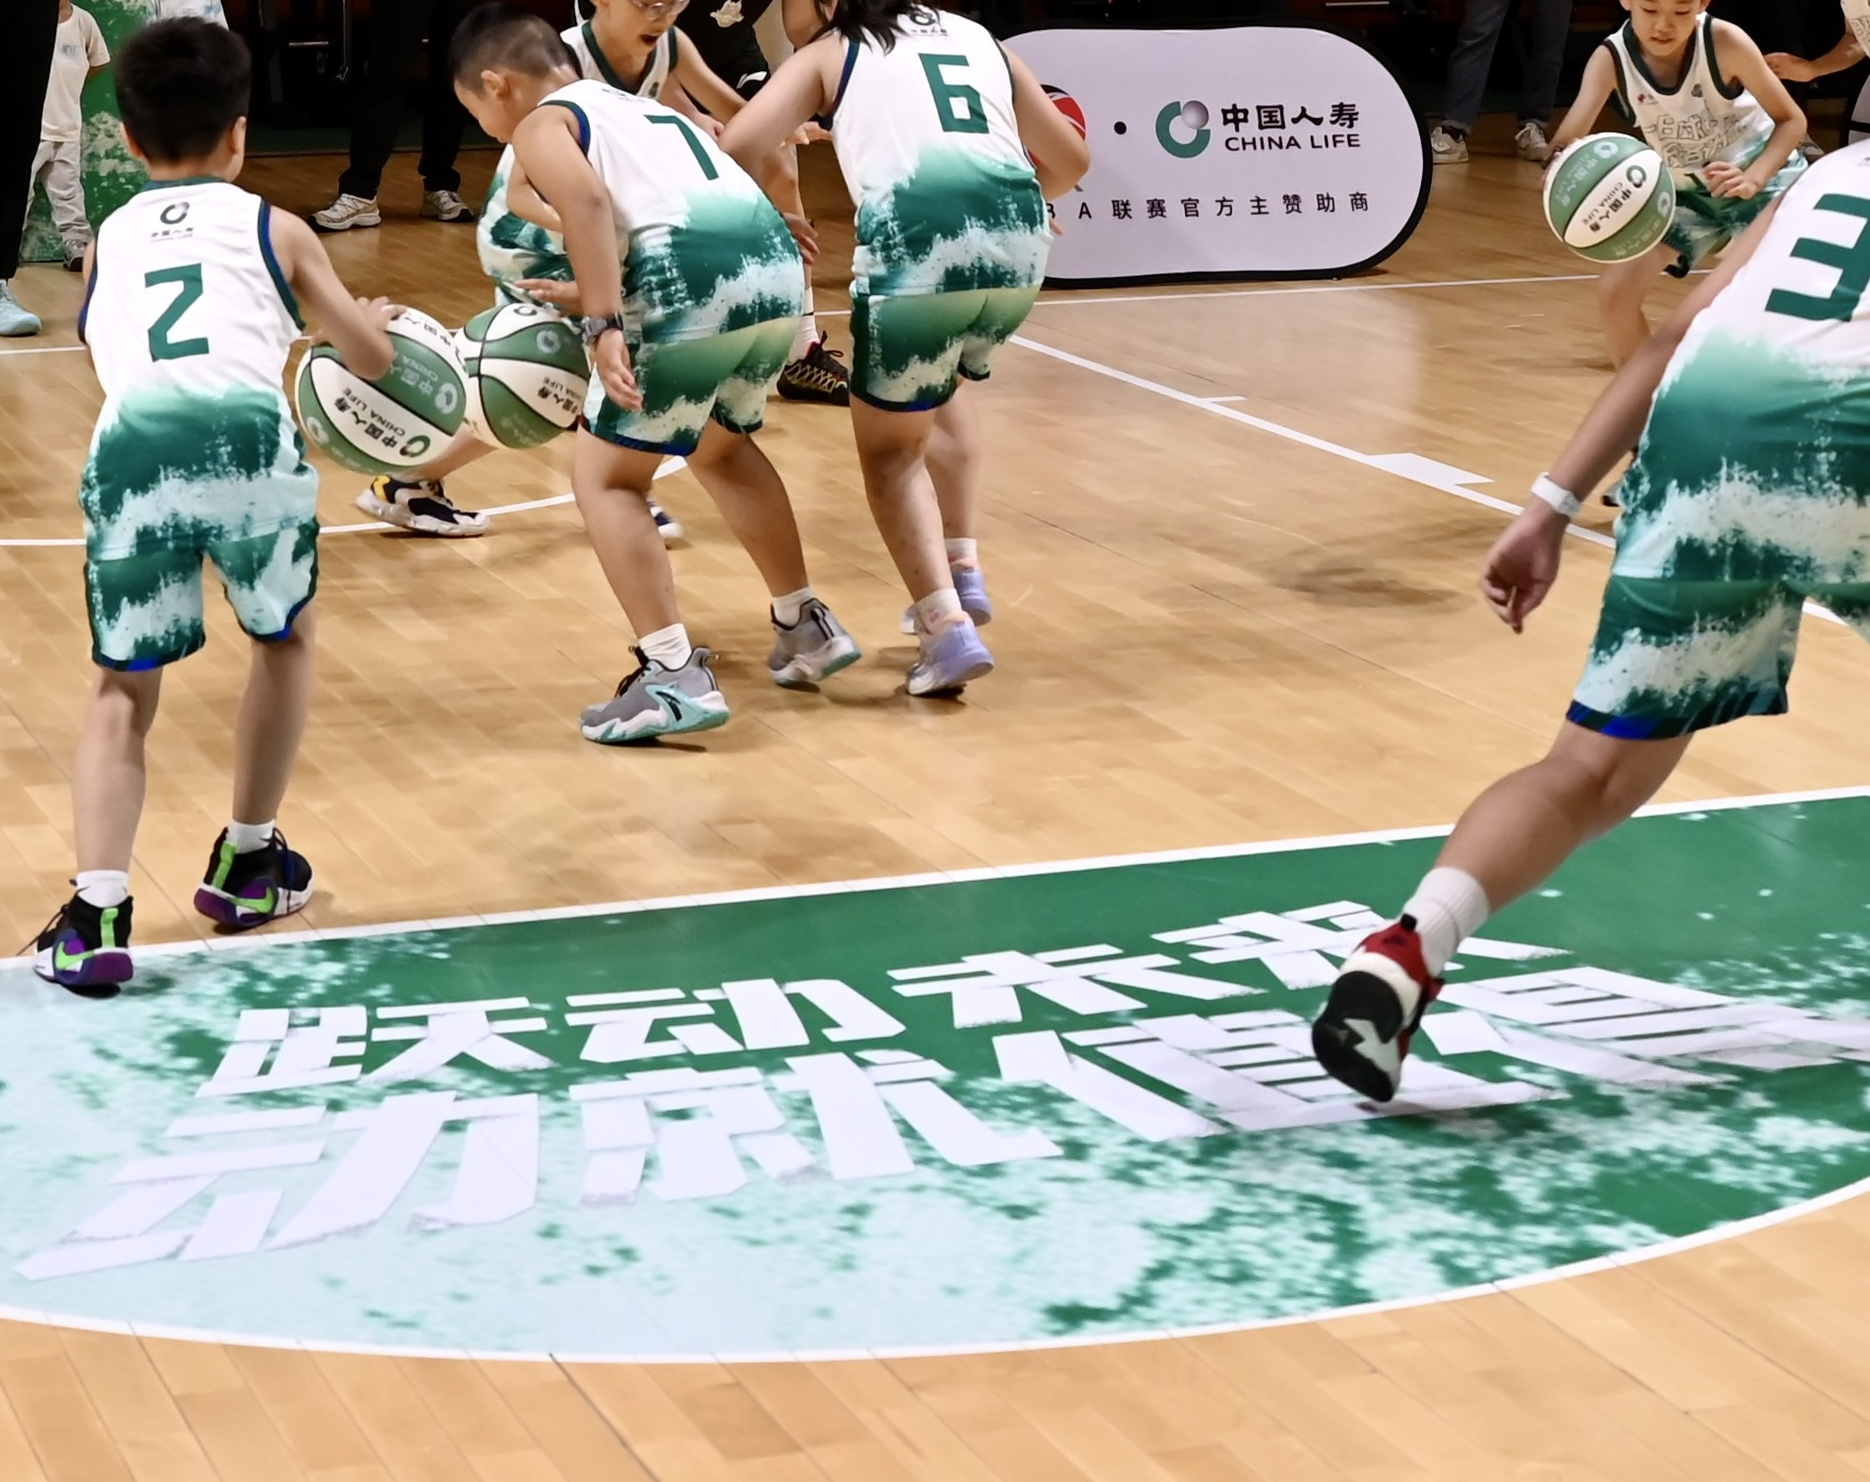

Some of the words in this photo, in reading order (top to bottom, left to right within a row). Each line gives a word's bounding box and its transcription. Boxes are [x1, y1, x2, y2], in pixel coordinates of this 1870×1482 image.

[918, 52, 990, 134] 6
[1220, 102, 1360, 133] 中国人寿
[643, 114, 719, 181] 7
[1224, 135, 1302, 152] CHINA
[1310, 133, 1361, 148] LIFE
[144, 262, 210, 363] 2
[195, 900, 1572, 1097] 跃动未来
